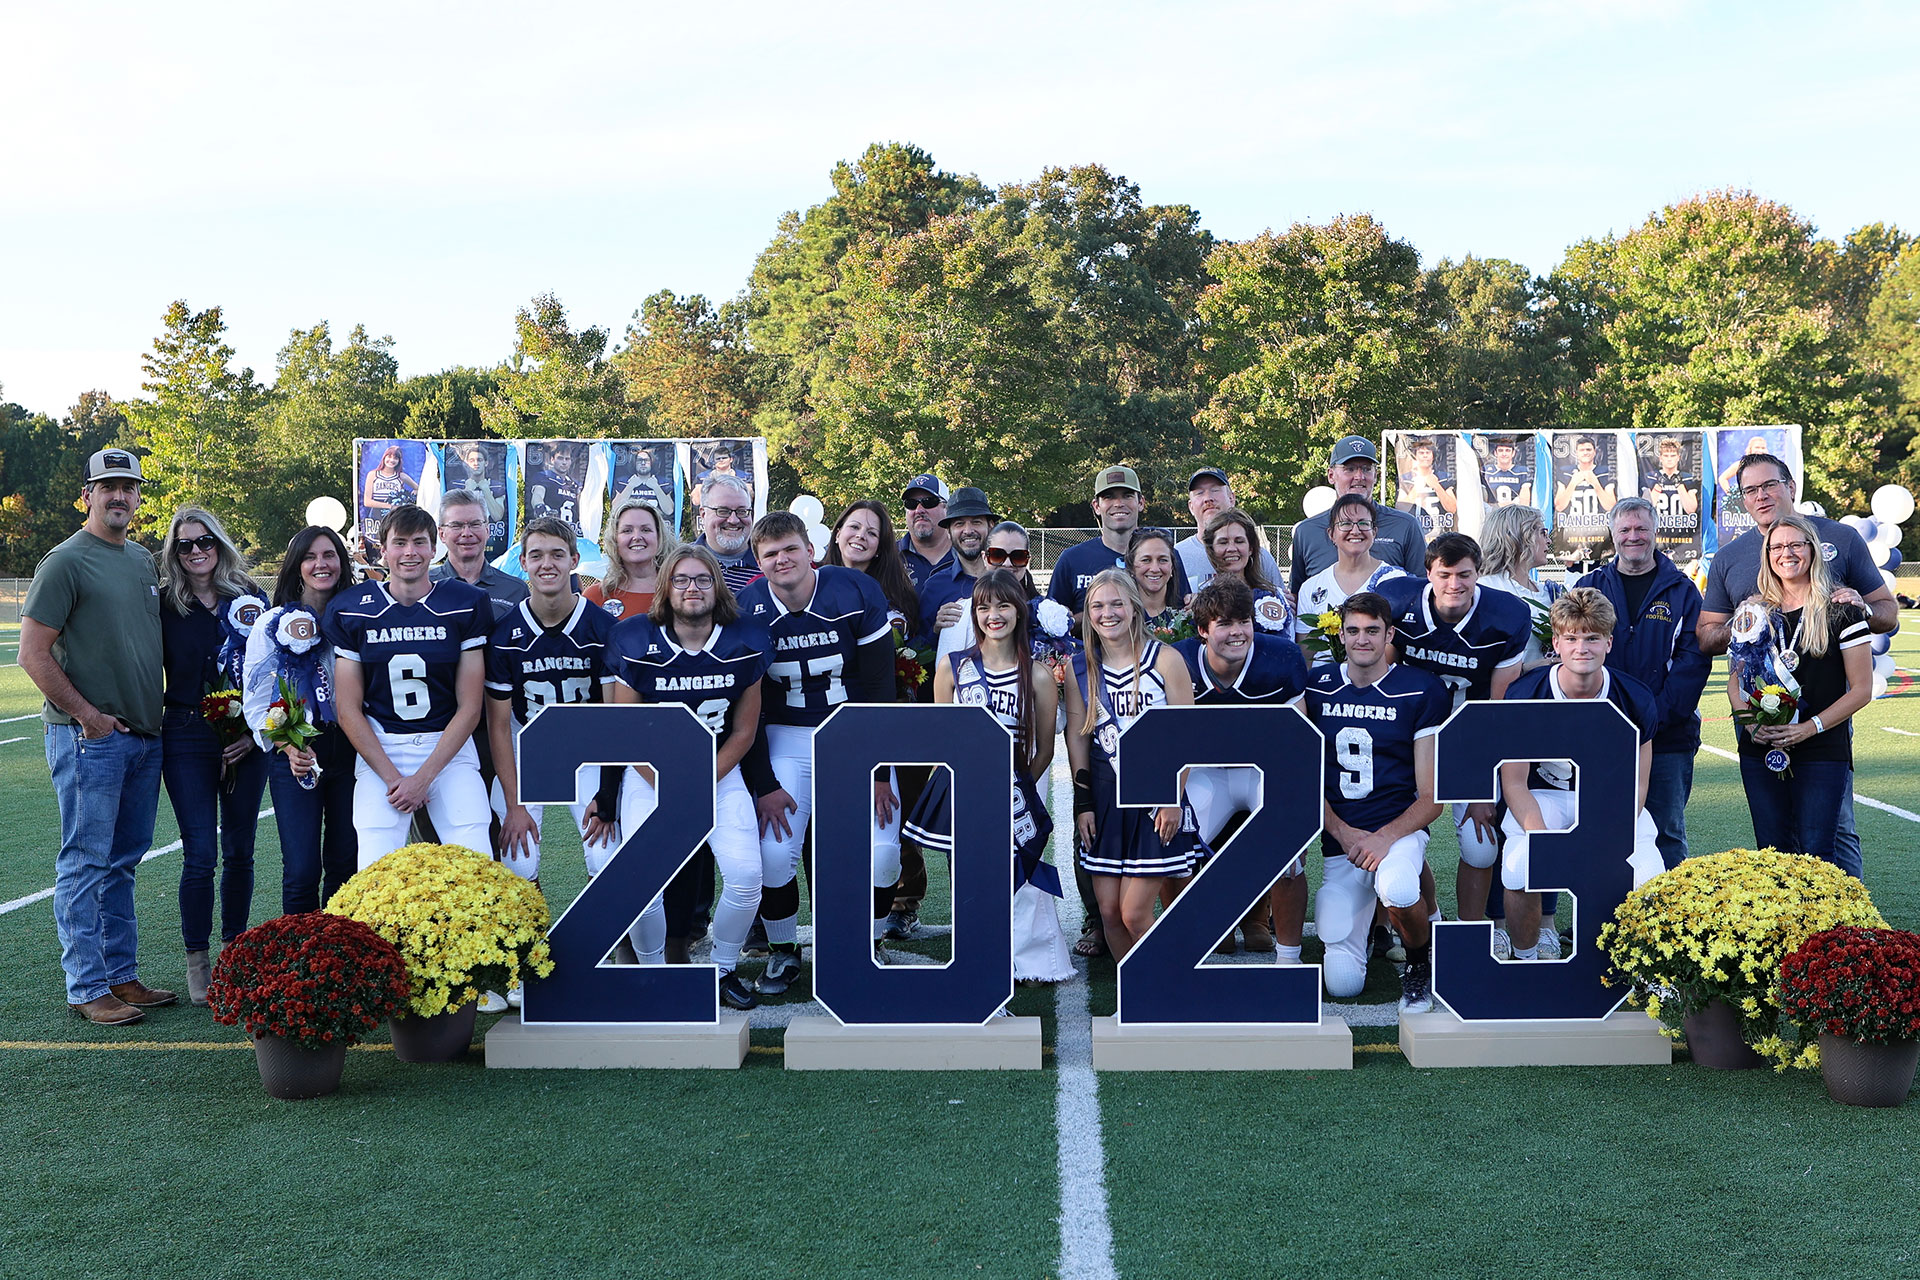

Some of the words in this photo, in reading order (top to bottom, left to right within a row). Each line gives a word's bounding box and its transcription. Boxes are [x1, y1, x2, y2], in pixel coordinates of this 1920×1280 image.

[527, 444, 544, 466] 6
[1473, 436, 1490, 459] 9
[1607, 435, 1617, 482] SENIOR
[1692, 434, 1703, 482] SENIOR
[559, 500, 575, 523] 6
[1570, 490, 1599, 515] 50
[1658, 512, 1698, 528] NGERS
[1684, 550, 1698, 558] 23
[243, 611, 258, 623] 27
[1266, 607, 1279, 618] 15
[1645, 614, 1673, 623] FOOTBALL
[298, 625, 308, 637] 6
[366, 626, 447, 644] RANGERS
[775, 630, 840, 651] ANGERS
[521, 656, 591, 674] RANGERS
[1405, 645, 1479, 670] RANGERS
[388, 653, 432, 721] 6
[655, 674, 735, 691] RANGERS
[766, 653, 849, 708] 77
[315, 686, 327, 702] 6
[1322, 703, 1397, 721] RANGERS
[1335, 726, 1374, 800] 9
